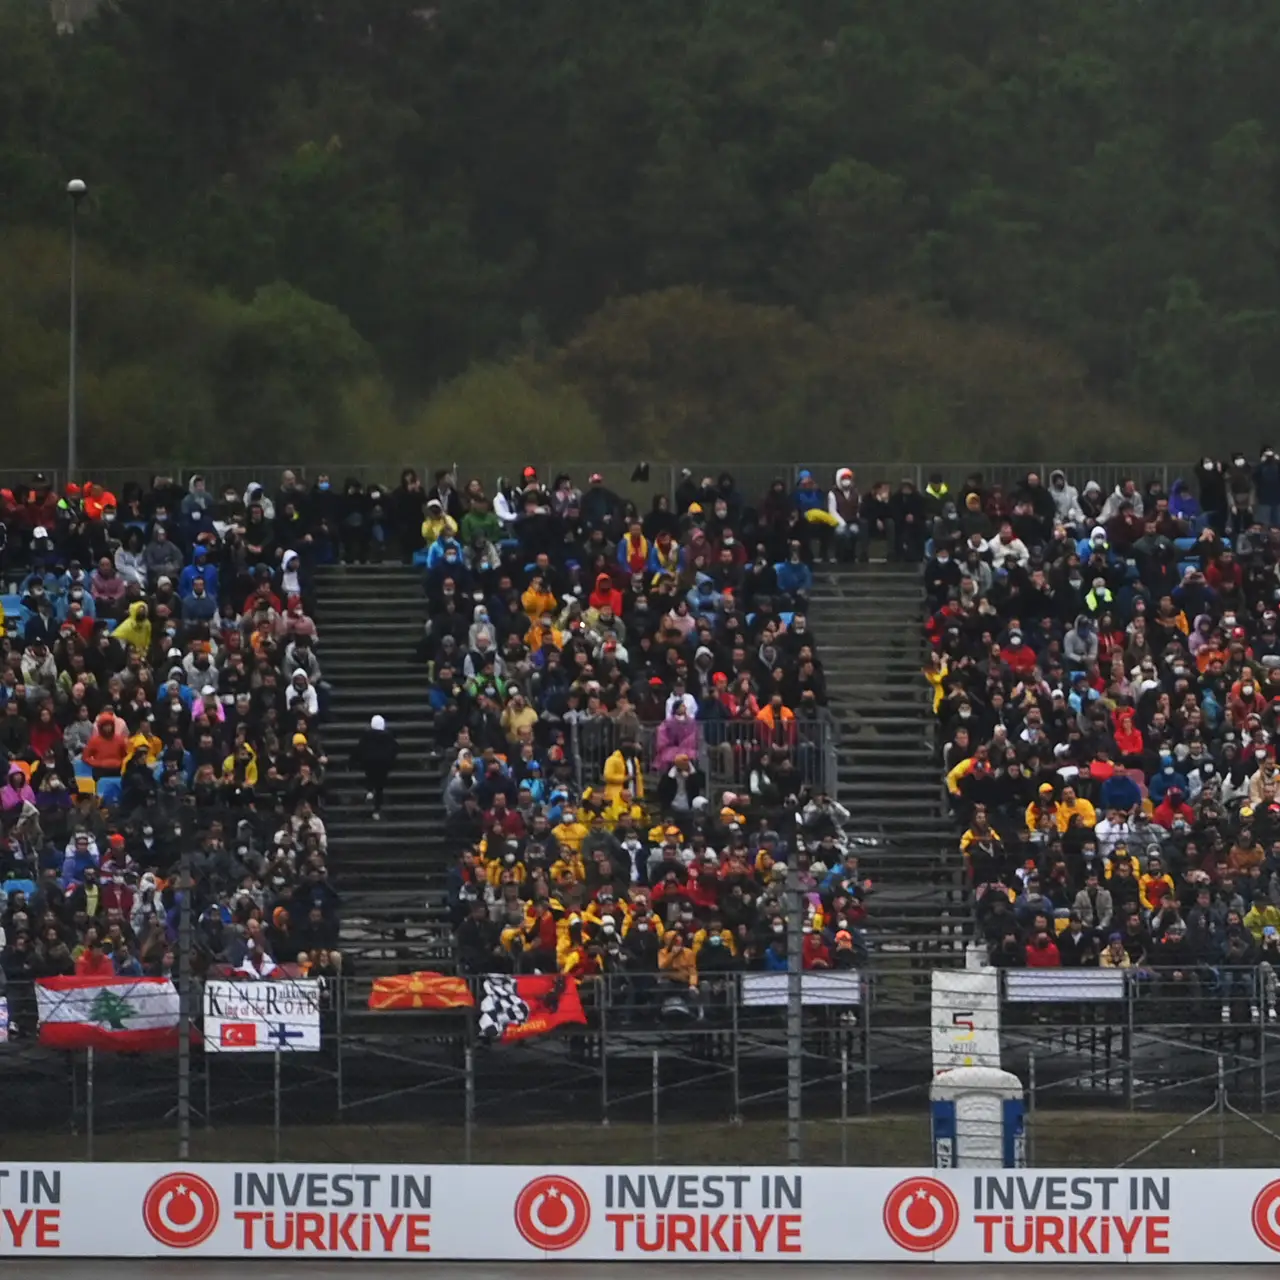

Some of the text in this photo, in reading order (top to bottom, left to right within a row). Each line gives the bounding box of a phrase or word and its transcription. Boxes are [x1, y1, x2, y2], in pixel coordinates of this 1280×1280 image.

[20, 1169, 61, 1204] IN
[235, 1173, 431, 1208] INVEST IN
[606, 1175, 801, 1208] INVEST IN
[974, 1177, 1170, 1210] INVEST IN
